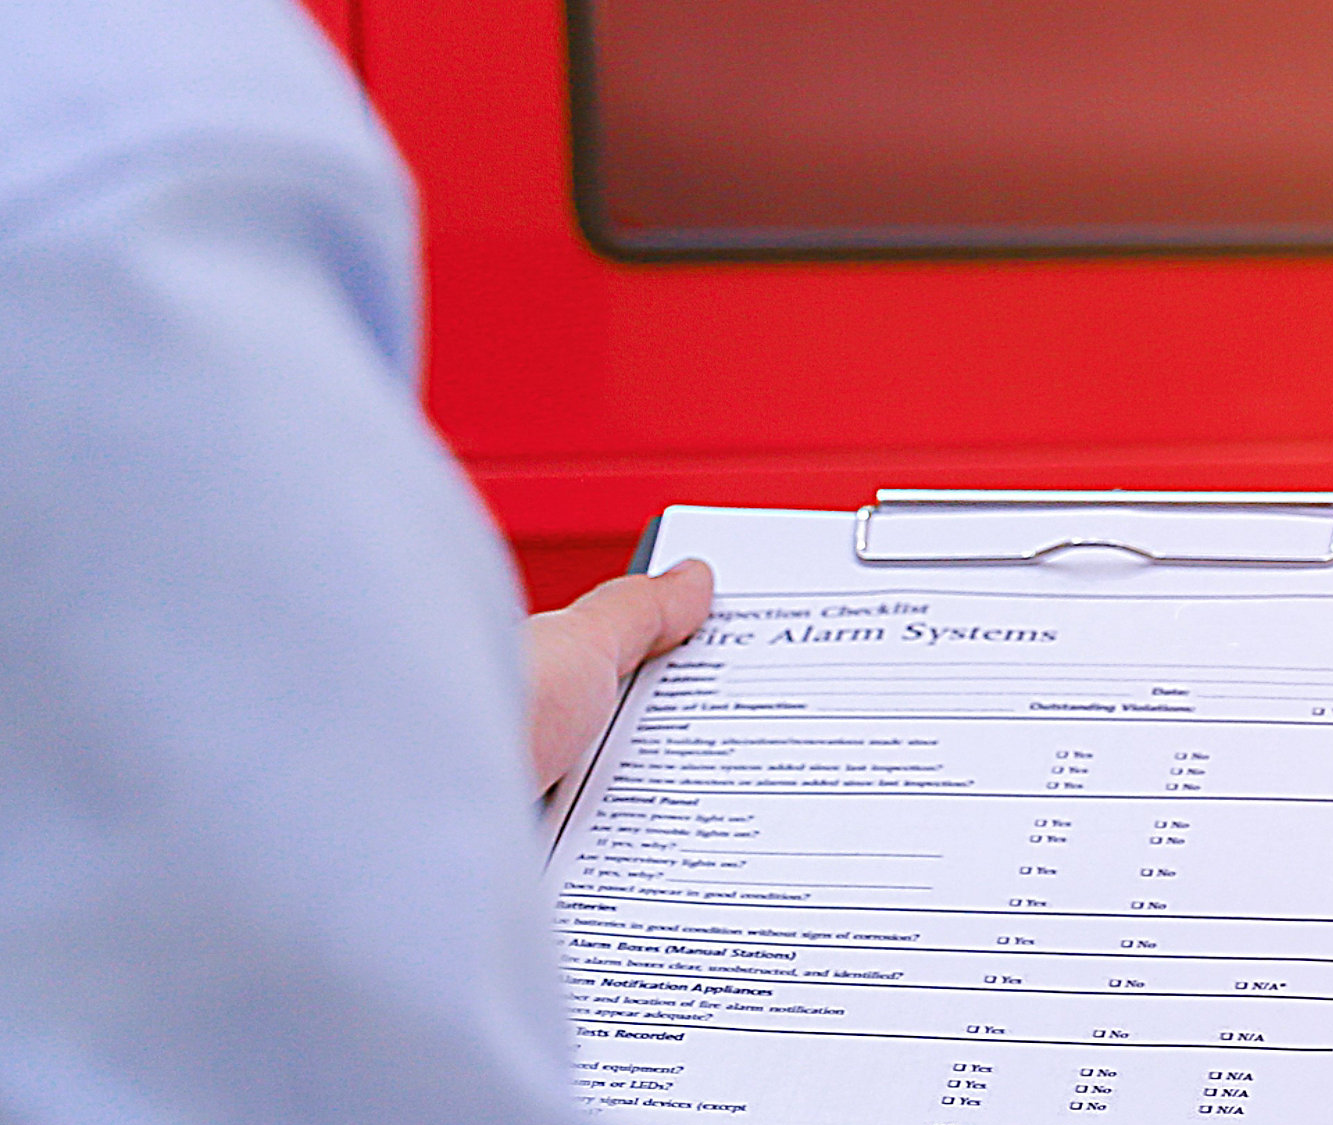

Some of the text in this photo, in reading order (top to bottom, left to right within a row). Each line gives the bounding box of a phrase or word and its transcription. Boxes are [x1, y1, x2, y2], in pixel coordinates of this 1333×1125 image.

[821, 602, 929, 618] Checklist
[768, 625, 885, 645] Alarm
[902, 621, 1057, 646] Systems
[1073, 751, 1210, 761] Yes No
[1068, 766, 1205, 776] Yes No
[1063, 782, 1200, 792] Yes No
[1051, 819, 1072, 828] Yes
[1171, 820, 1190, 829] No
[1046, 835, 1067, 844] Yes
[1166, 836, 1185, 845] No
[1036, 867, 1057, 875] Yes
[1157, 868, 1176, 877] No
[1026, 899, 1047, 908] Yes
[1147, 901, 1166, 910] No
[569, 938, 611, 949] Alarm
[617, 942, 660, 953] Boxes
[665, 945, 727, 957] (Manual
[732, 948, 797, 961] Stations)
[1014, 936, 1035, 945] Yes
[1137, 939, 1156, 949] No
[563, 975, 773, 996] larm Notification Appliances
[1002, 975, 1022, 984] Yes
[1125, 979, 1145, 988] No
[623, 997, 676, 1007] location
[726, 1003, 763, 1012] alarm
[769, 1005, 845, 1015] notification
[595, 1008, 639, 1018] appear
[643, 1010, 713, 1021] adequate?
[984, 1026, 1005, 1035] Yes
[1110, 1030, 1129, 1039] No
[1238, 1033, 1265, 1042] N/A
[576, 1027, 685, 1041] Tests Recorded
[602, 1064, 684, 1075] equipment?
[971, 1064, 993, 1073] Yes
[1097, 1069, 1117, 1078] No
[1226, 1071, 1254, 1081] N/A
[574, 1079, 605, 1089] mps
[630, 1081, 673, 1091] LEDs?
[965, 1080, 987, 1090] Yes
[1092, 1085, 1112, 1095] No
[1220, 1088, 1249, 1098] N/A
[601, 1098, 638, 1107] signal
[643, 1099, 692, 1109] devices
[697, 1102, 747, 1114] (except
[960, 1097, 981, 1107] Yes
[1086, 1102, 1107, 1112] No
[1215, 1105, 1244, 1115] N/A
